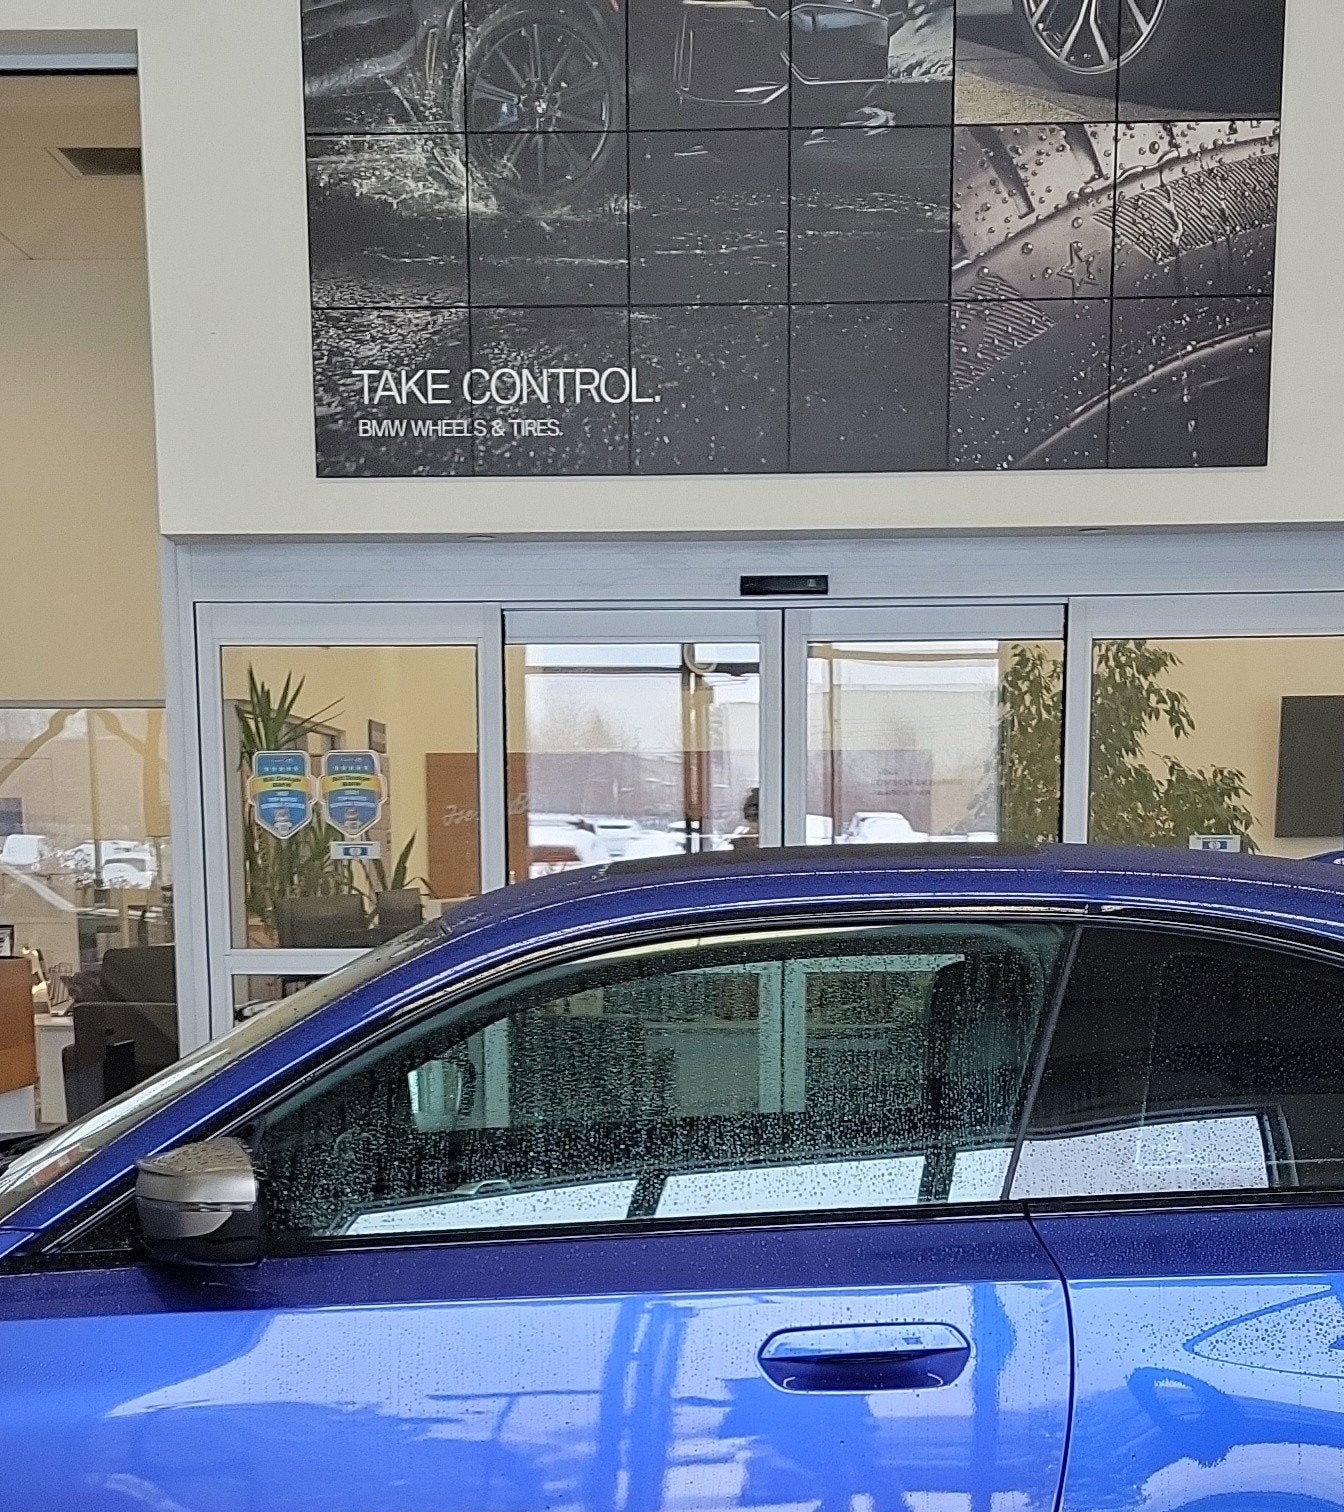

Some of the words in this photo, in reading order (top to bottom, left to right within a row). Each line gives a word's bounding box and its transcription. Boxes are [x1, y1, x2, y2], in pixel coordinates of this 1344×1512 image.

[352, 369, 452, 405] TAKE
[462, 367, 661, 404] CONTROL.
[358, 419, 407, 437] BMW
[410, 419, 487, 437] WHEELS
[492, 419, 505, 436] &
[508, 419, 564, 436] TIRES.
